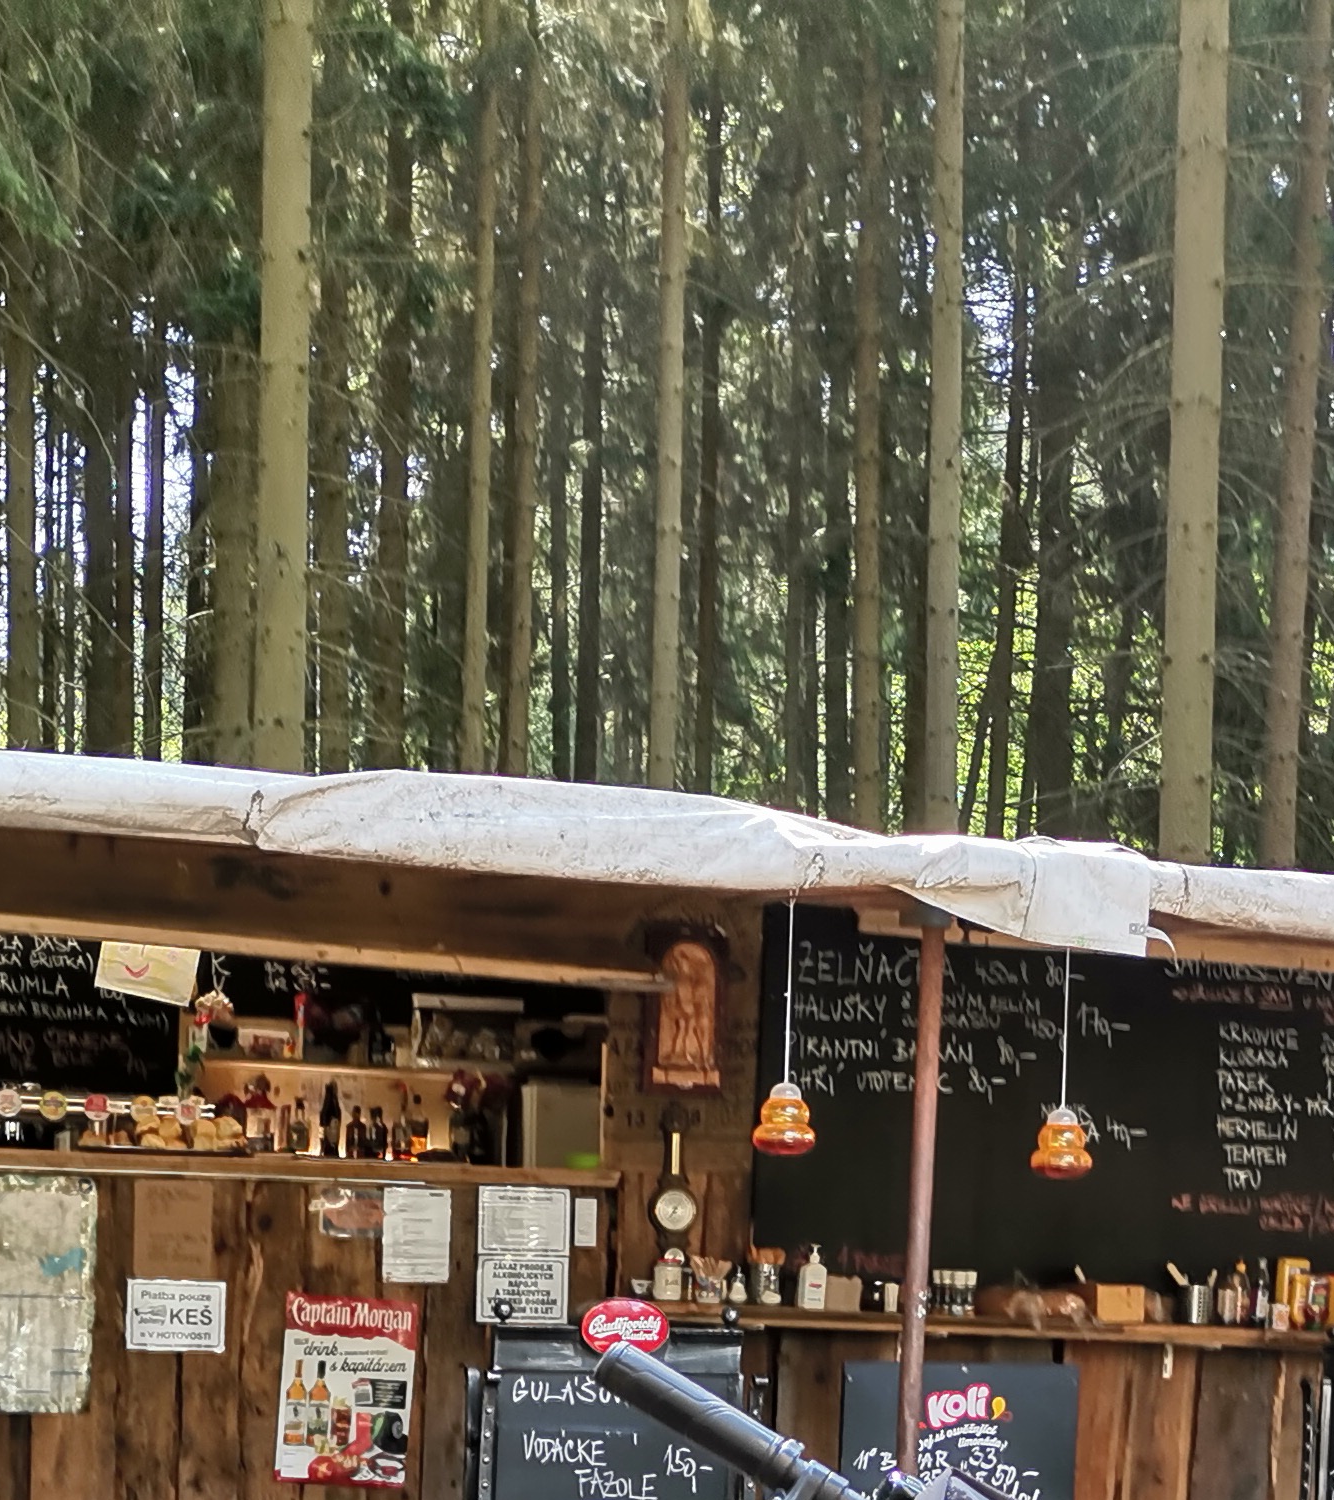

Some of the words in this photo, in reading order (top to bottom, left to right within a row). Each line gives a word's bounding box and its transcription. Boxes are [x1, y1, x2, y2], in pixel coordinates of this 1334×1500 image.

[141, 1290, 175, 1300] Platba
[178, 1292, 211, 1302] pouze
[170, 1305, 212, 1326] KEŠ
[292, 1297, 351, 1328] Captain
[349, 1302, 412, 1332] Morgan
[541, 1307, 554, 1315] LET
[304, 1341, 339, 1356] drink
[340, 1358, 407, 1375] kapitánem
[928, 1386, 989, 1428] Koli
[576, 1467, 658, 1500] FAZOLE
